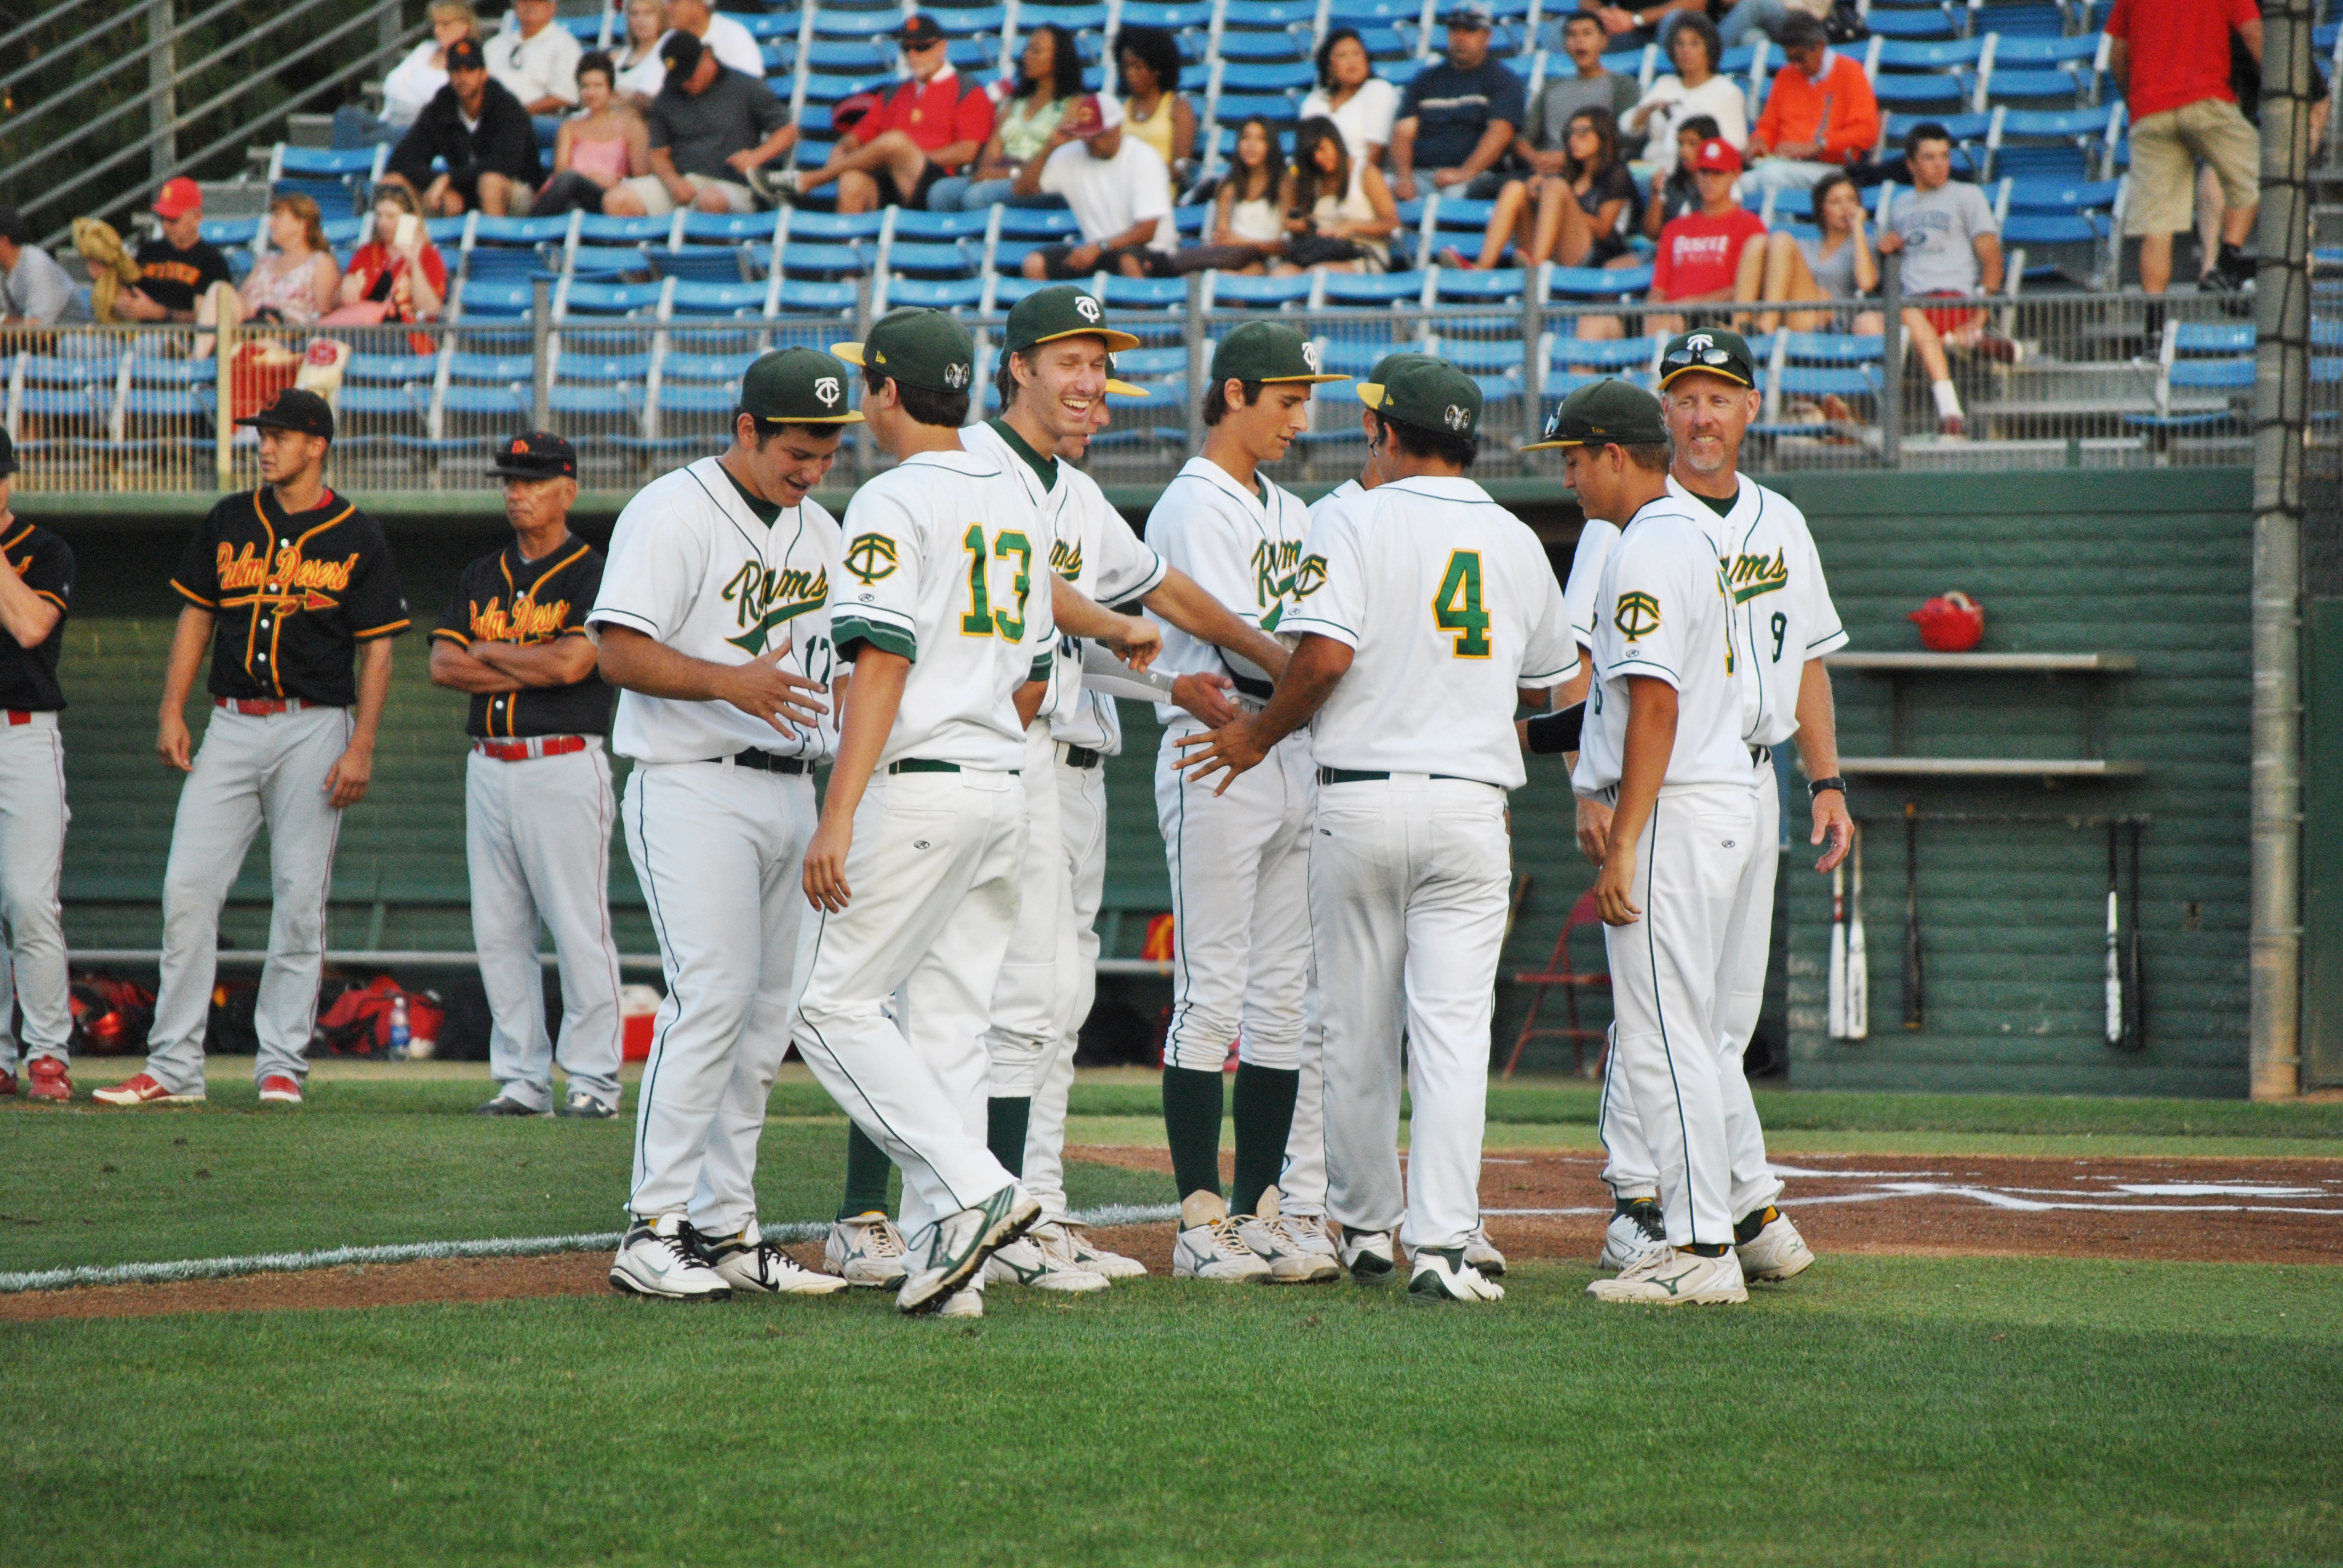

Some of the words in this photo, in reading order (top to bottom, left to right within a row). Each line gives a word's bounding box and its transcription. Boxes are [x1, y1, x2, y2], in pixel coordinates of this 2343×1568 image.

[217, 541, 265, 590] Palm
[266, 546, 360, 592] Desert
[721, 560, 829, 629] Rams
[960, 522, 1032, 644] 13
[1431, 547, 1492, 659] 4
[1771, 610, 1788, 664] 9
